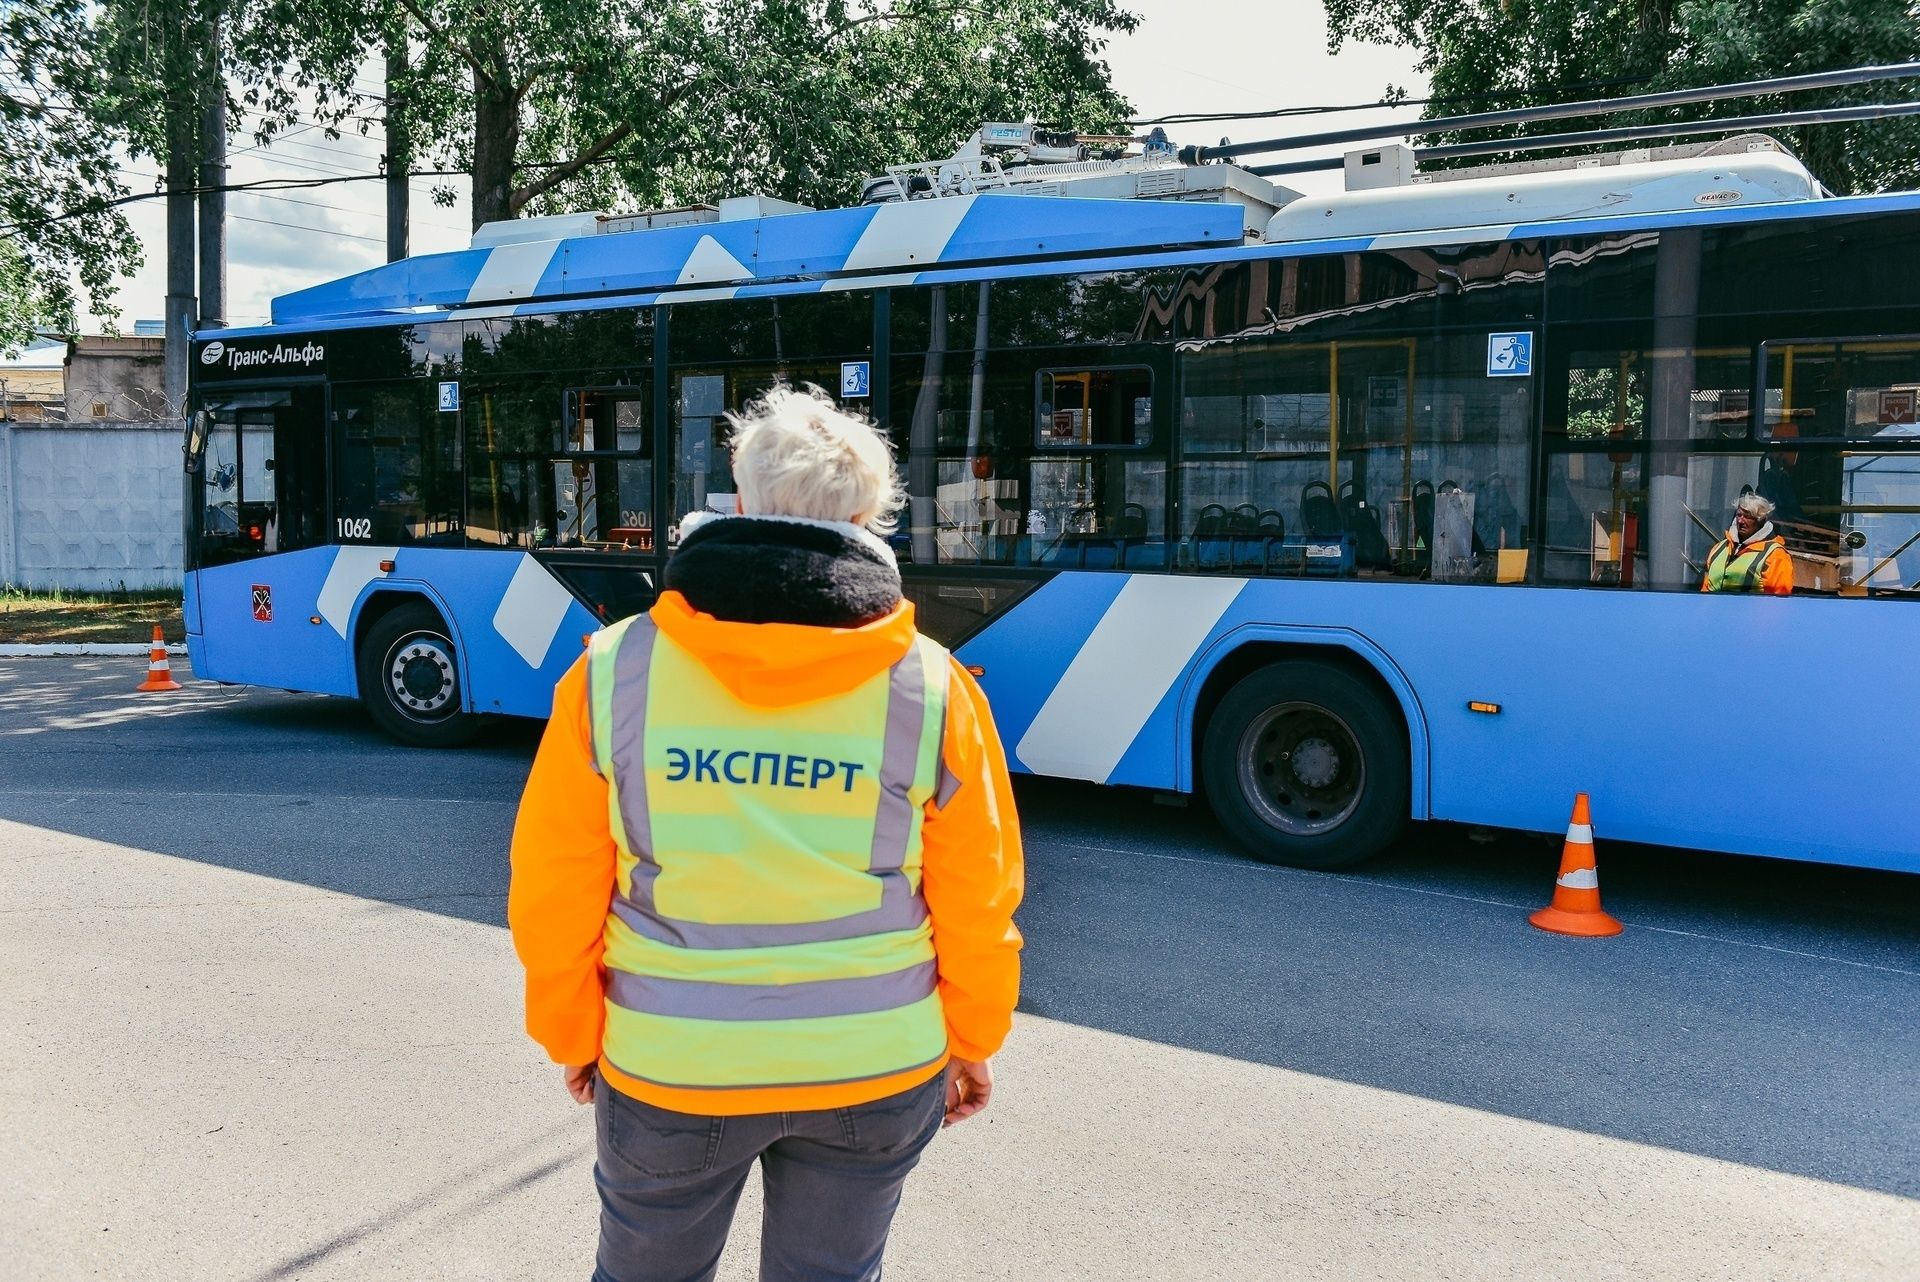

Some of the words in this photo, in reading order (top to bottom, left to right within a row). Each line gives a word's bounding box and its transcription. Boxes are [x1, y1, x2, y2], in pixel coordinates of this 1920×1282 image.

[991, 128, 1022, 138] FESTO
[1701, 193, 1728, 201] HEAVAC
[226, 341, 324, 371] Транс-Альфа
[337, 517, 372, 539] 1062
[666, 747, 864, 793] ЭКСПЕРТ
